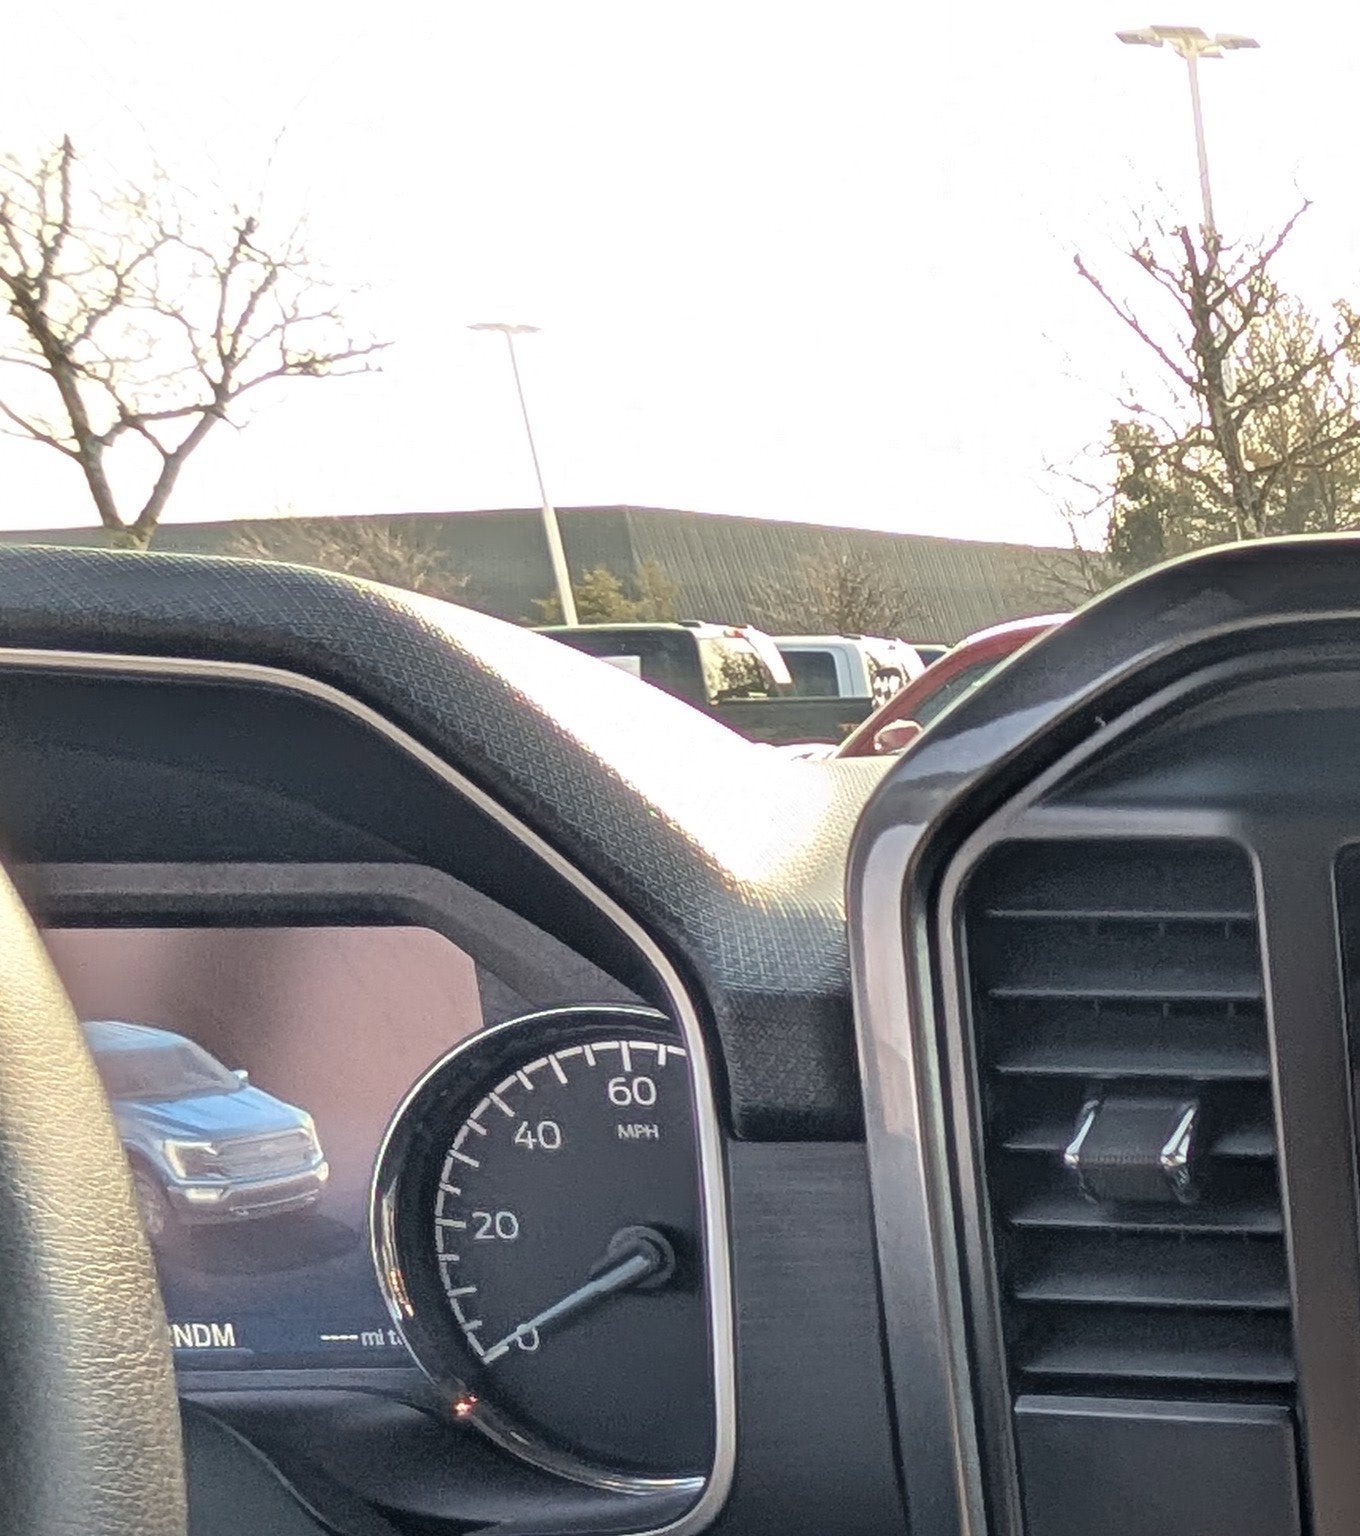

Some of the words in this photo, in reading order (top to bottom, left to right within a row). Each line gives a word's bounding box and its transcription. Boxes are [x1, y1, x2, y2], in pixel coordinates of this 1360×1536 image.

[608, 1076, 656, 1105] 60
[515, 1121, 561, 1149] 40
[618, 1124, 659, 1138] MPH
[473, 1211, 518, 1239] 20
[514, 1324, 540, 1352] 0
